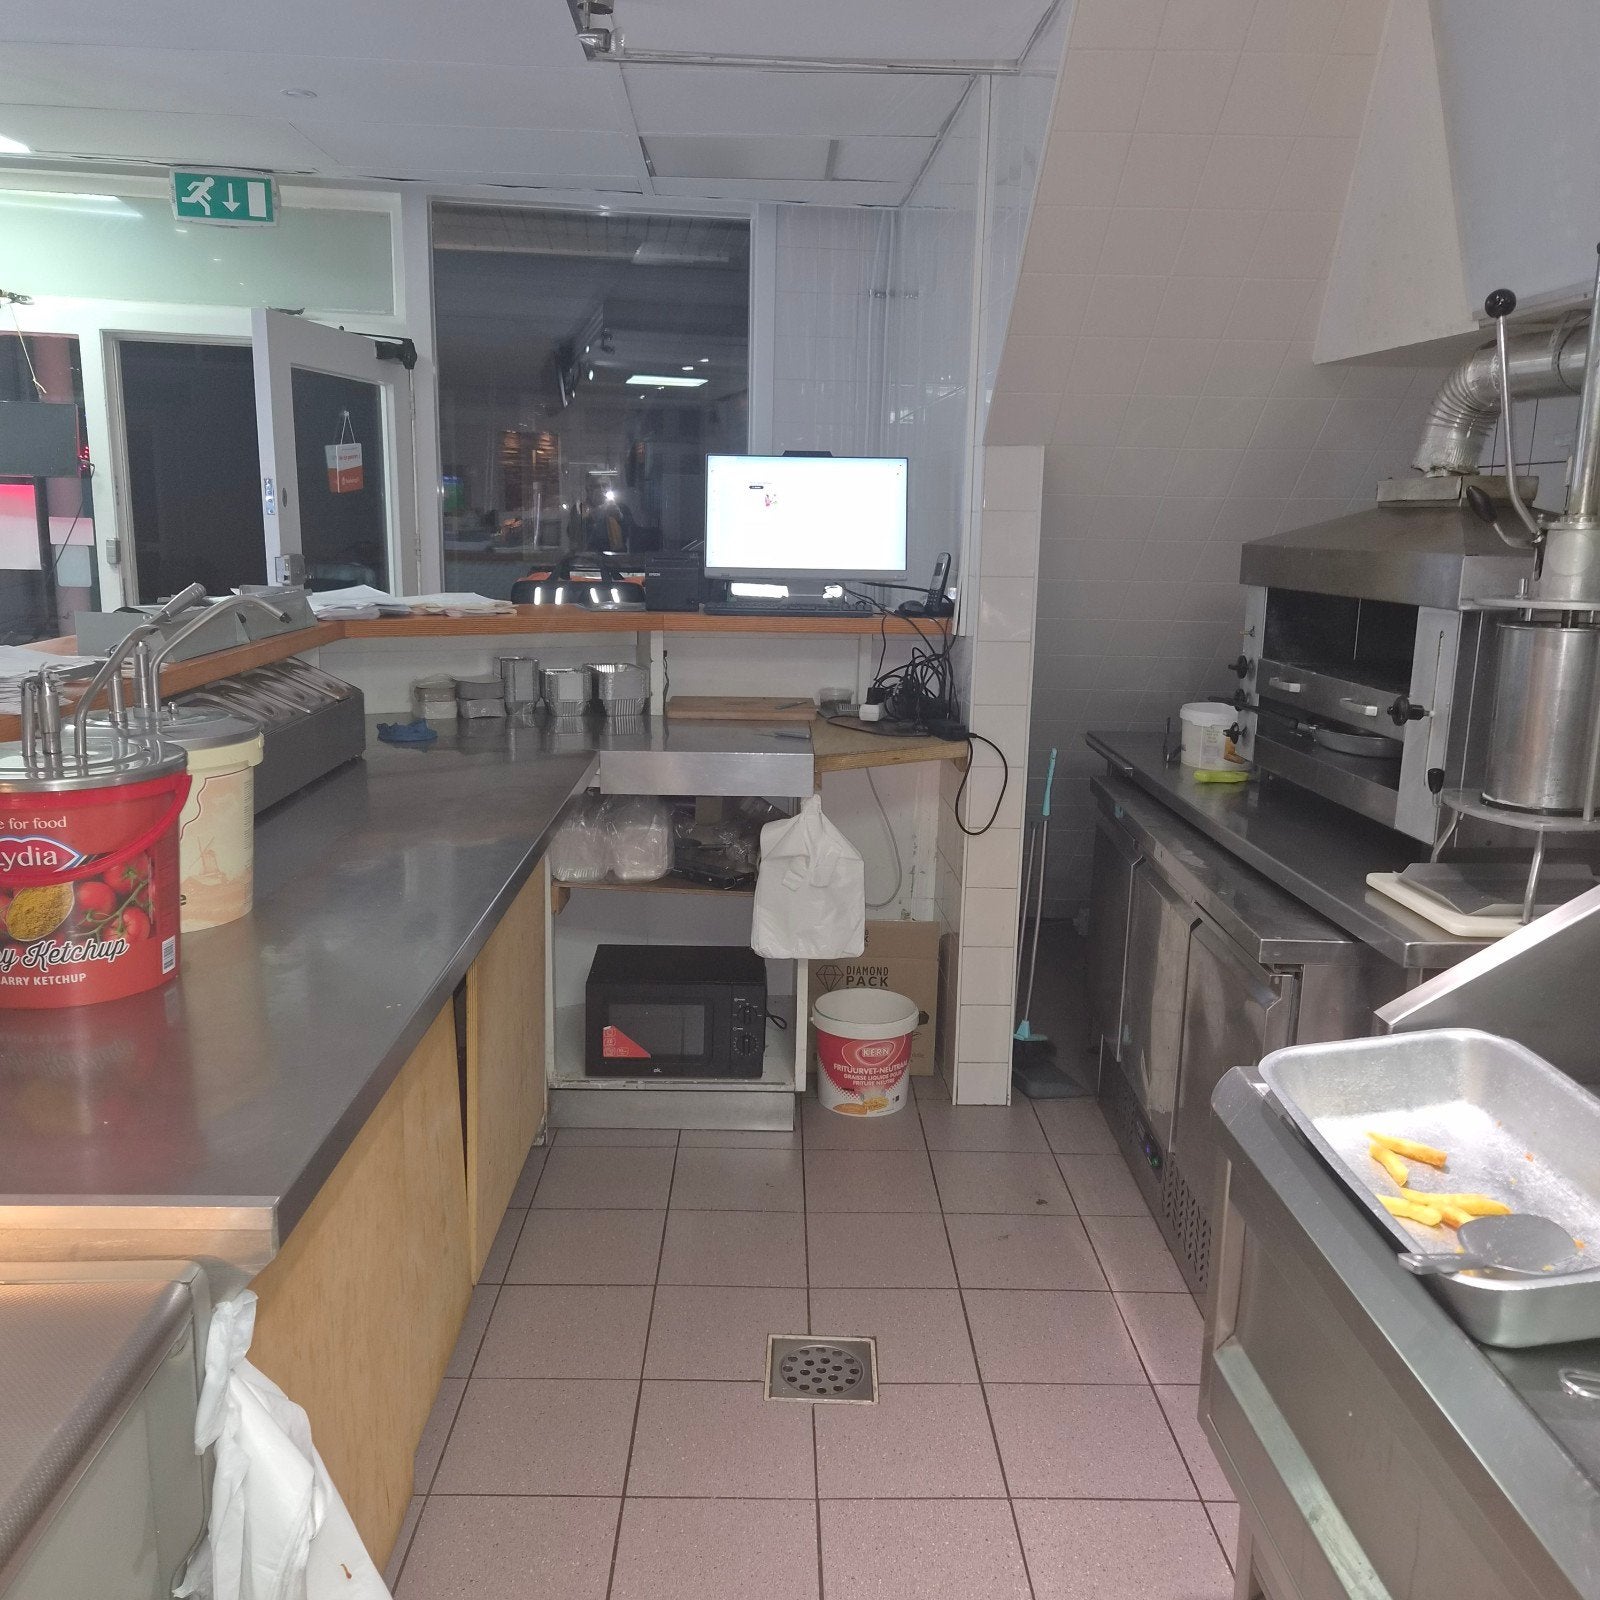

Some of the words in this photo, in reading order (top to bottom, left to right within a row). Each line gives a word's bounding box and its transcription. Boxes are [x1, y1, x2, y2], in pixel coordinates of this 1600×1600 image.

[9, 817, 29, 830] for
[32, 815, 67, 829] food
[0, 845, 58, 872] ydia
[20, 938, 130, 972] Ketchup
[846, 965, 889, 976] DIAMOND
[0, 976, 30, 986] ARRY
[33, 973, 87, 986] KETCHUP
[846, 975, 889, 987] PACK
[862, 1048, 889, 1057] KERN
